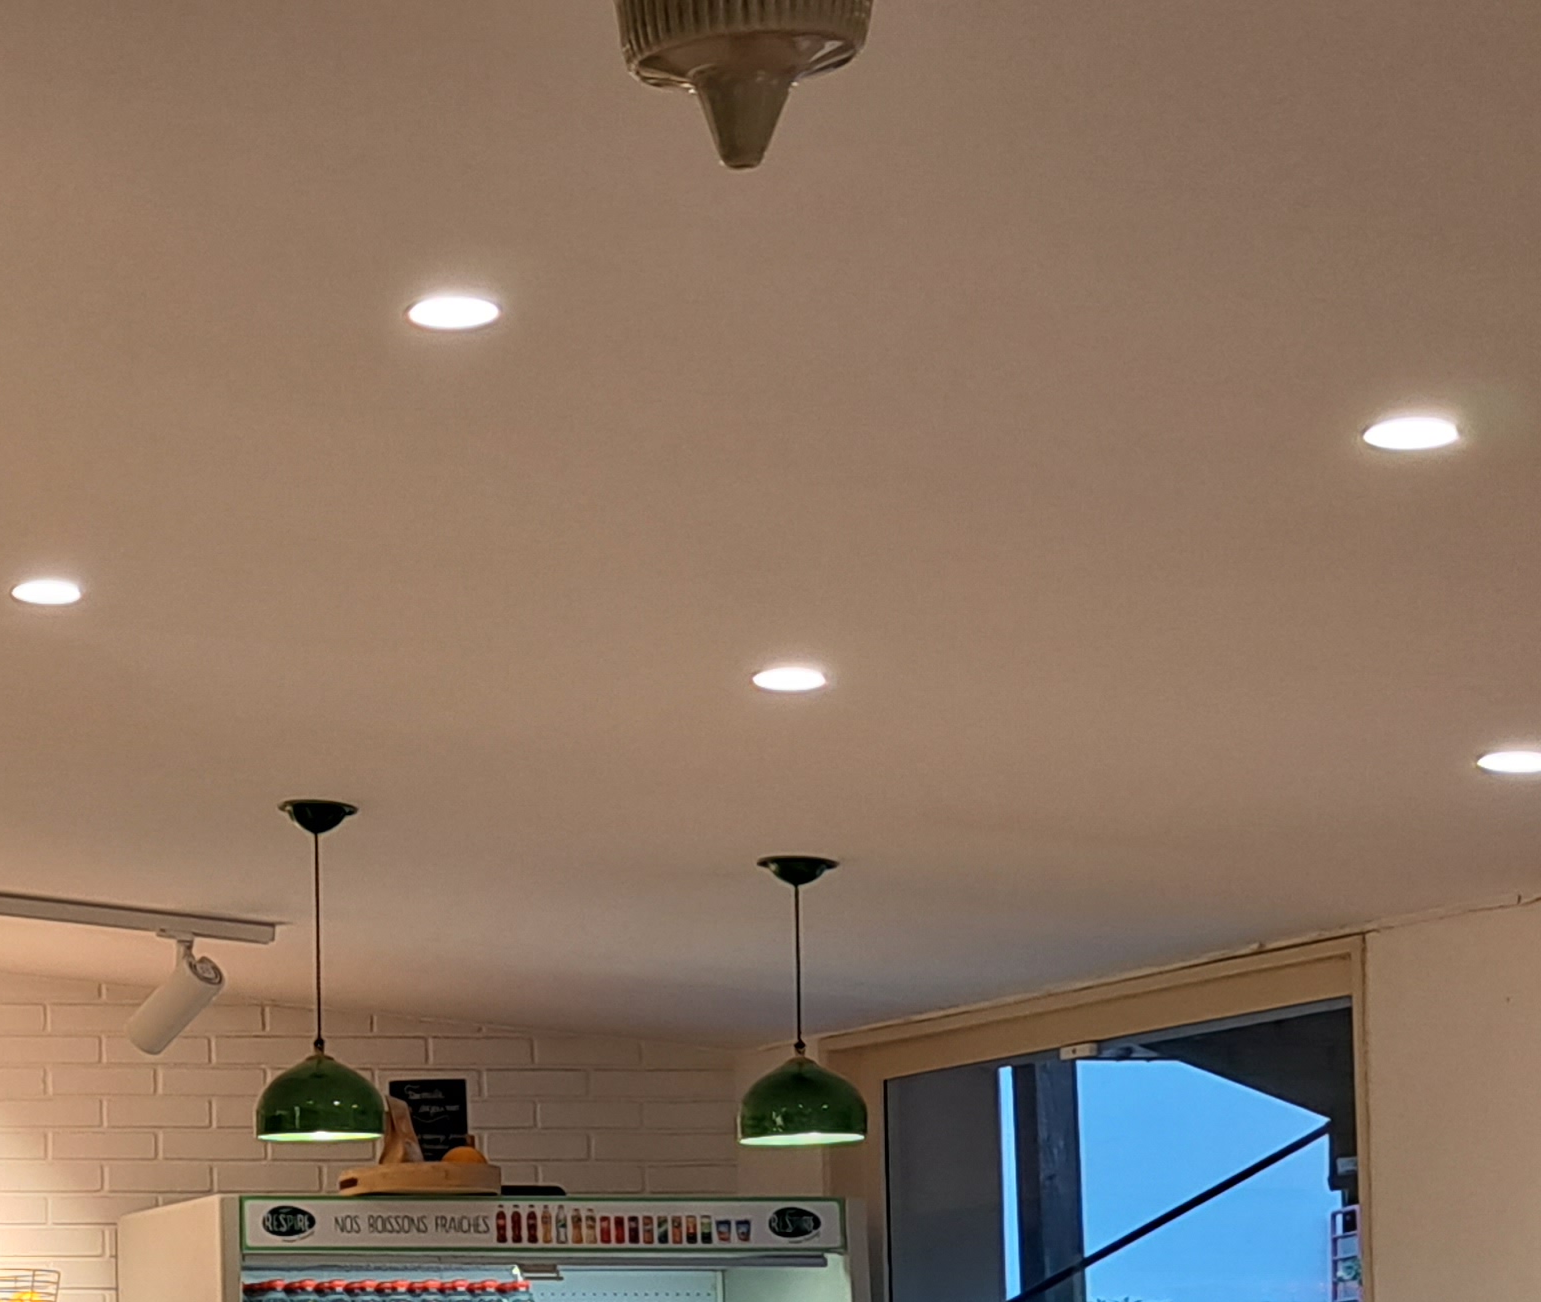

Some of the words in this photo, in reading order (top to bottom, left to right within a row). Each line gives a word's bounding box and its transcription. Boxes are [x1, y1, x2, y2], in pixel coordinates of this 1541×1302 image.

[265, 1213, 311, 1233] RESPIRE
[334, 1215, 362, 1235] NOS
[368, 1215, 429, 1235] BOISSONS
